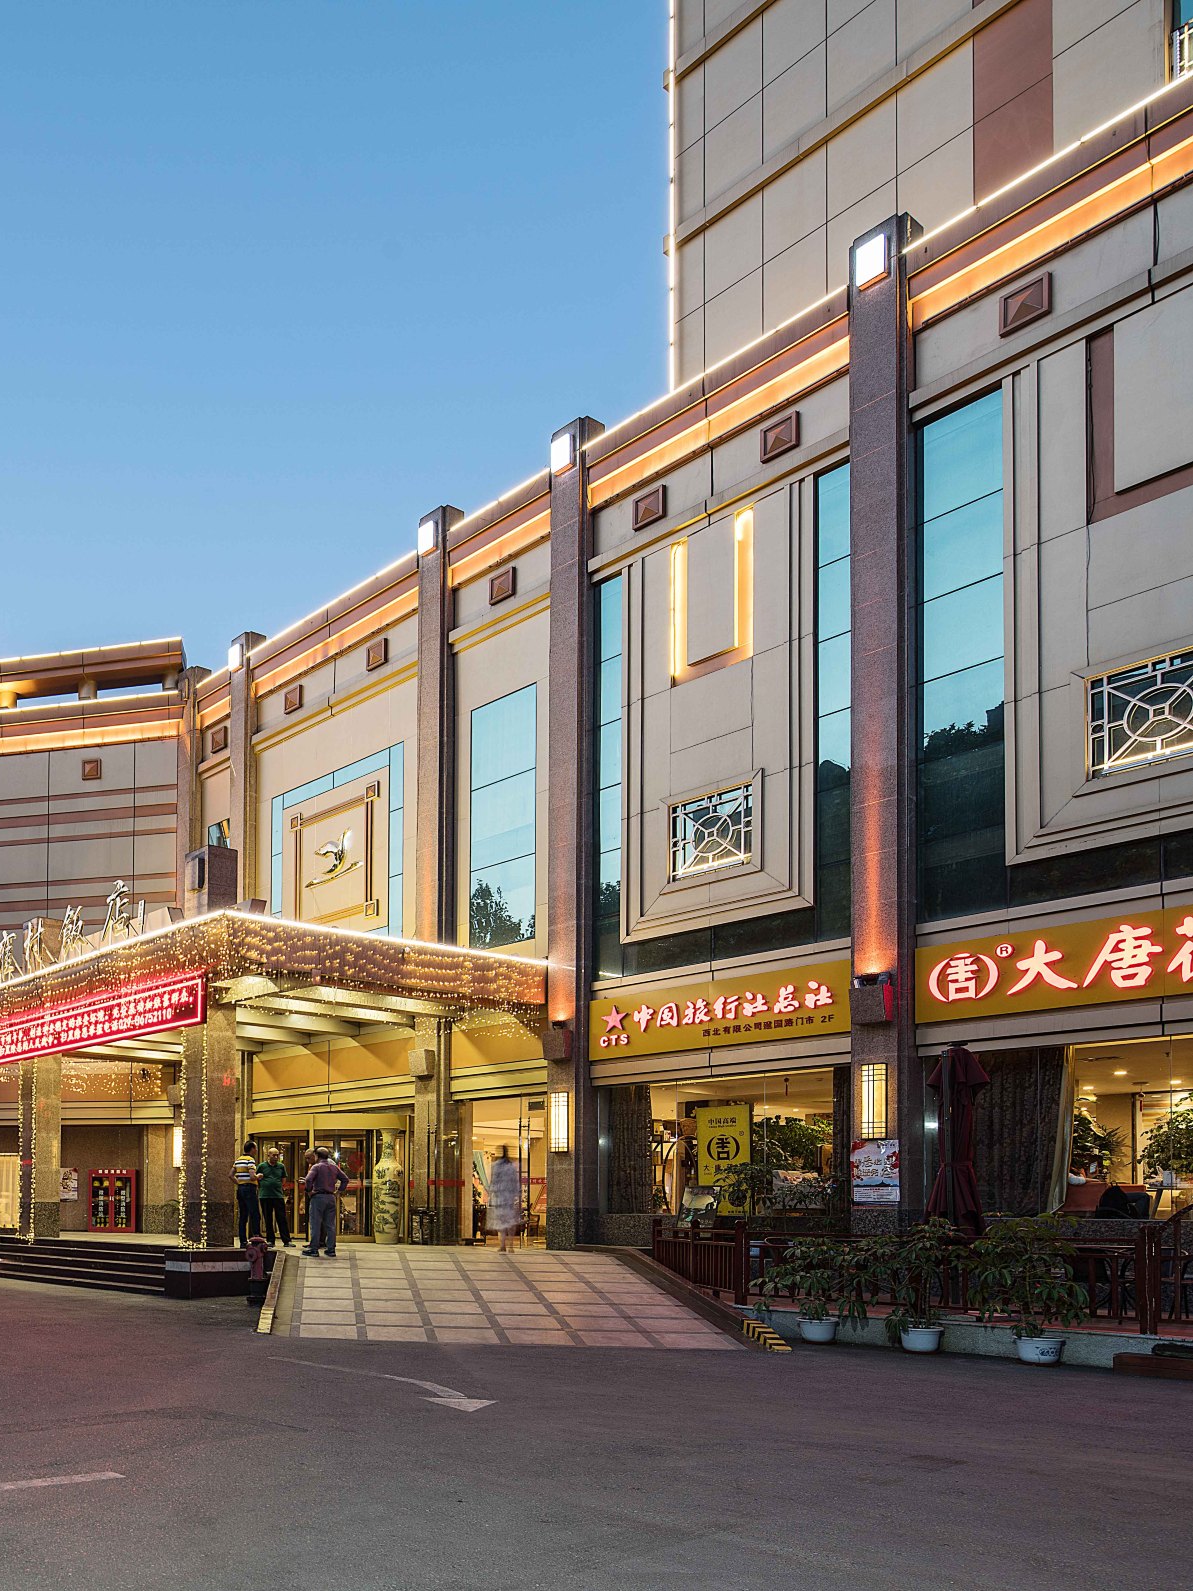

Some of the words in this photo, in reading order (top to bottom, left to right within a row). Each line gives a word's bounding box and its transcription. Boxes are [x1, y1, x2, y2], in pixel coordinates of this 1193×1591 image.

[633, 980, 834, 1032] 中国旅行社总社
[600, 1033, 630, 1048] CTS
